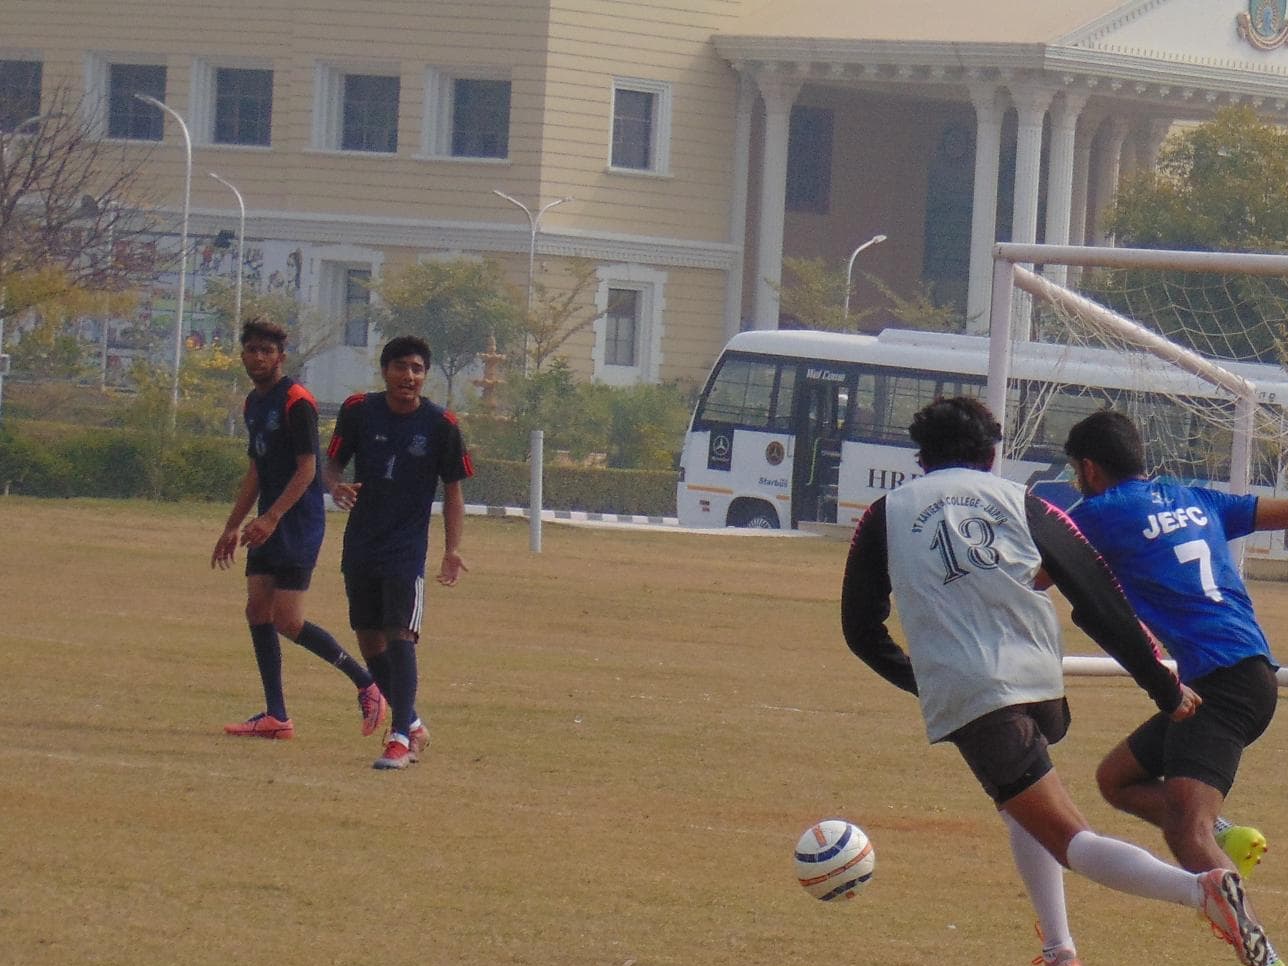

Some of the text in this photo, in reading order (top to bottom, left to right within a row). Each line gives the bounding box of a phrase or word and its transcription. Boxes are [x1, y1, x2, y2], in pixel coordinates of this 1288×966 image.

[384, 454, 396, 480] 1
[866, 468, 924, 490] HR
[945, 496, 980, 508] COLLEGE
[1142, 506, 1208, 539] JEFC
[930, 516, 1000, 585] 13
[1173, 539, 1224, 602] 7
